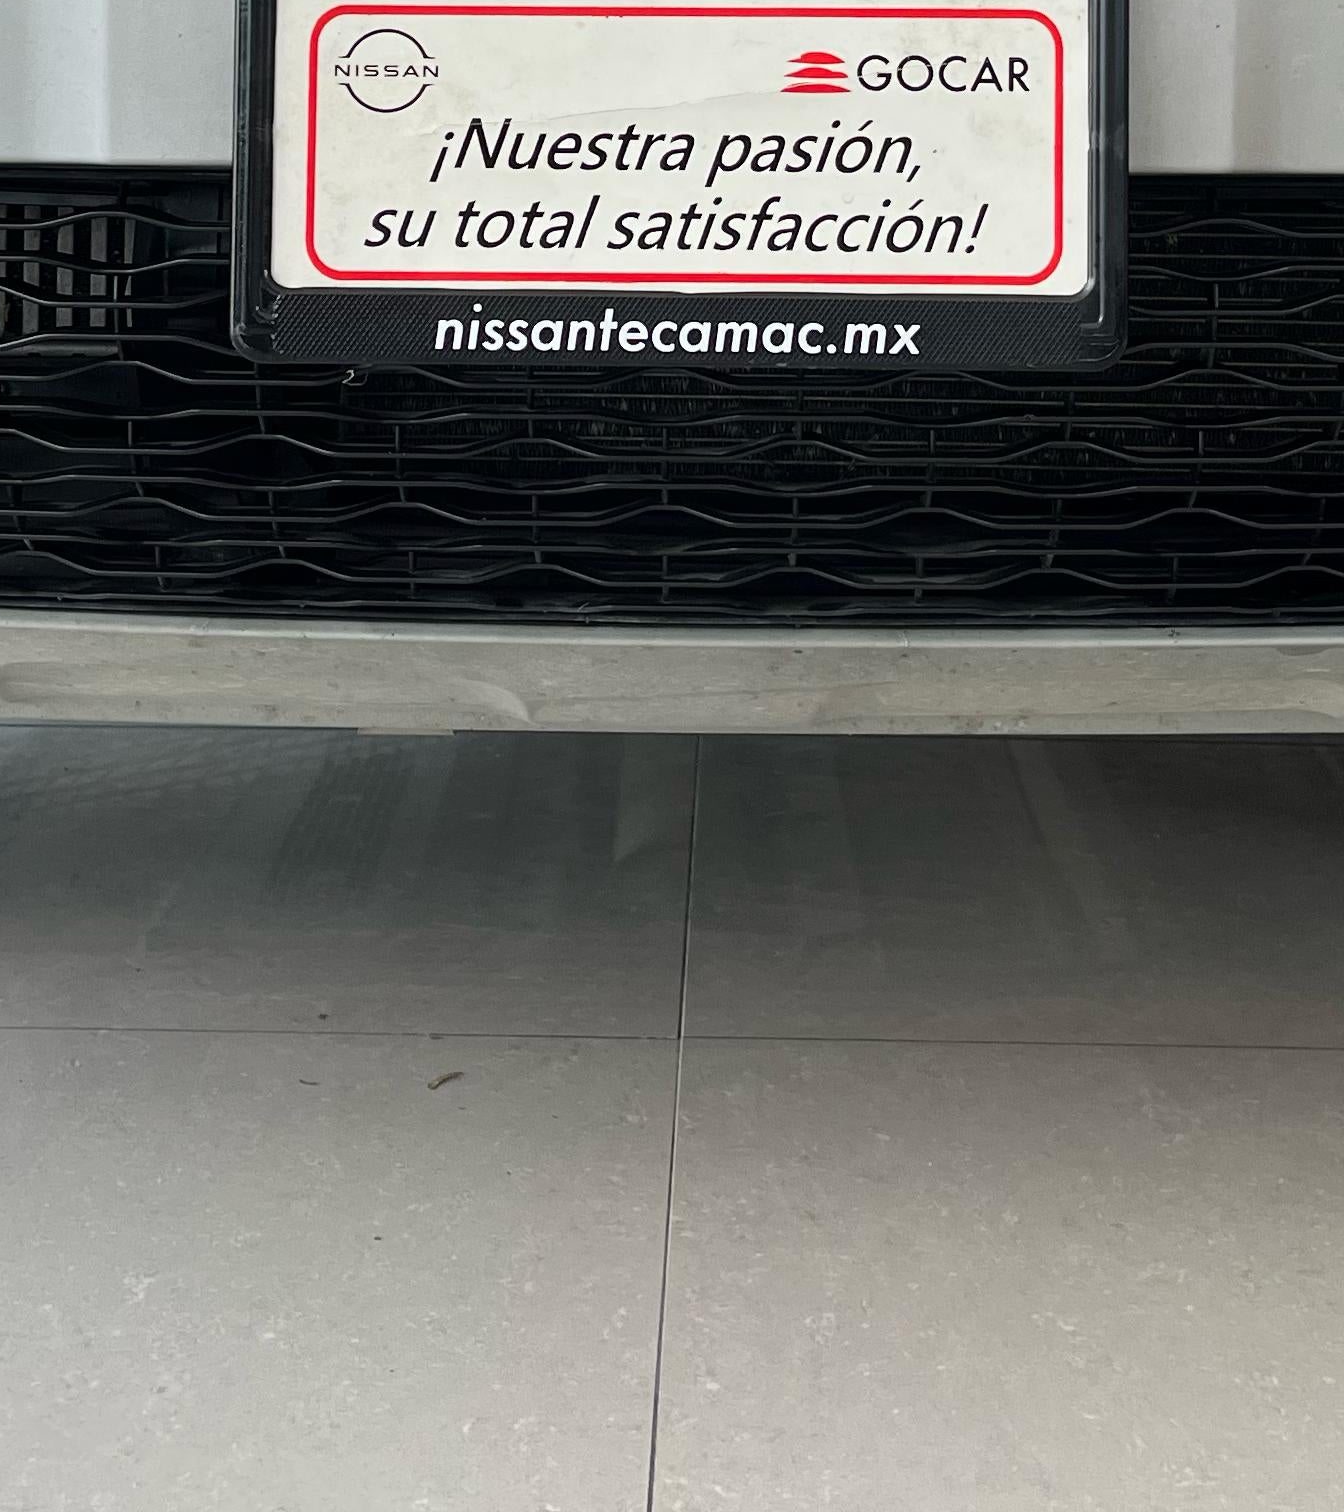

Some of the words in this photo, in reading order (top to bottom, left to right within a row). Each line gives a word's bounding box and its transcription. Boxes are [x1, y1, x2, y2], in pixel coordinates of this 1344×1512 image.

[334, 63, 440, 79] NISSAN
[855, 54, 1031, 94] GOCAR
[429, 117, 695, 184] ¡Nuestra
[703, 119, 922, 188] pasión,
[362, 202, 436, 249] su
[454, 195, 602, 250] total
[607, 196, 989, 255] satisfacción!
[433, 303, 922, 356] nissantecamac.mx
